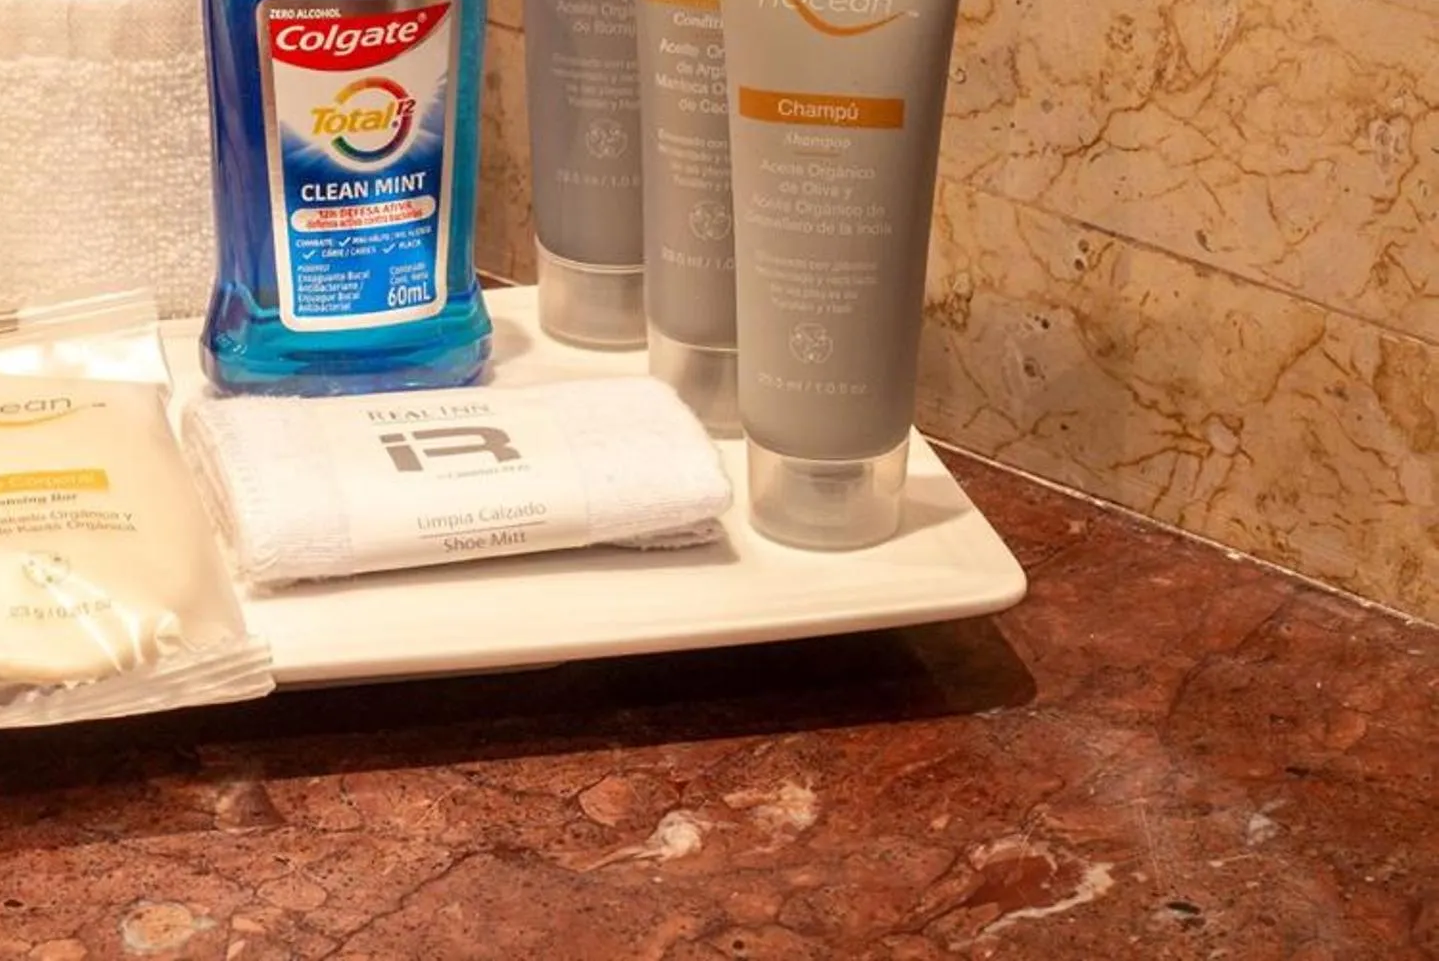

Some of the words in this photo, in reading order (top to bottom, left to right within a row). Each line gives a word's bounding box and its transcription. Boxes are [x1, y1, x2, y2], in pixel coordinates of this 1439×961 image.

[276, 21, 418, 56] Colgate
[777, 97, 860, 125] Champú
[300, 179, 369, 203] CLEAN
[373, 172, 427, 195] MINT
[388, 282, 431, 309] 60mL
[478, 501, 547, 522] Calzado
[443, 535, 486, 553] Shoe
